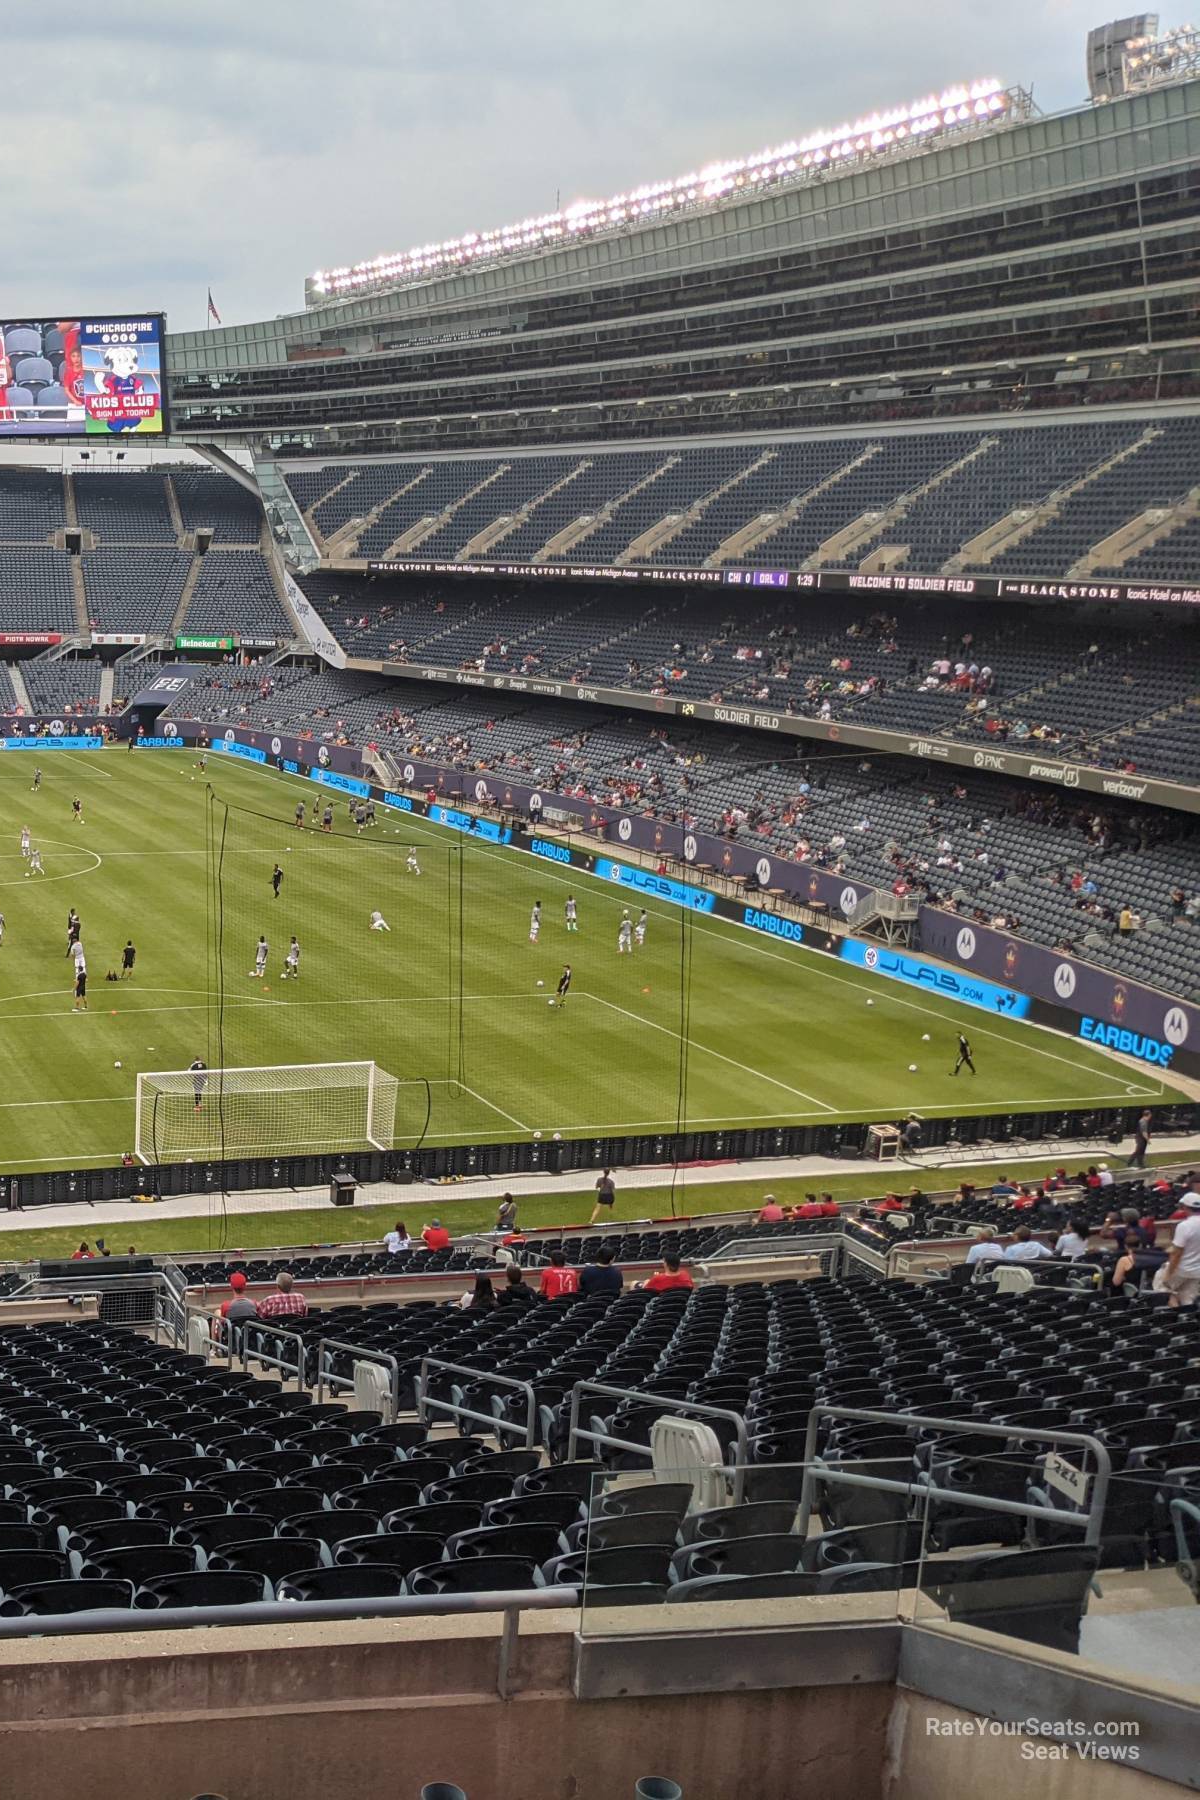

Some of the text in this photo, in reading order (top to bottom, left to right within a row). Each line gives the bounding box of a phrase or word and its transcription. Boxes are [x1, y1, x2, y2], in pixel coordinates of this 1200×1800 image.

[91, 395, 154, 408] KIDS CLUB
[96, 410, 113, 418] SIGN
[114, 409, 123, 417] UP
[378, 563, 432, 573] BLACKSTONE
[507, 566, 567, 576] BLACKSTONE
[570, 567, 584, 576] Iconic
[583, 567, 596, 576] Hotel
[601, 568, 622, 578] Michigan
[621, 569, 638, 578] Avenue
[652, 571, 721, 582] BLACKSTONE
[727, 572, 751, 584] CHI 0
[759, 573, 784, 585] ORL 0
[797, 574, 813, 586] 1:29
[849, 575, 975, 593] WELCOME TO SOLDIER FIELD
[1020, 584, 1120, 599] BLACKSTONE
[1126, 588, 1149, 600] Iconic
[1150, 588, 1170, 601] Hotel
[1170, 592, 1181, 601] on
[180, 639, 217, 648] Heineken
[533, 684, 555, 693] UNITED
[584, 690, 598, 700] PNC
[714, 709, 779, 729] SOLDIER FIELD
[137, 736, 184, 747] EARBUDS
[984, 755, 1005, 770] PNC
[1103, 780, 1142, 798] verizon
[384, 791, 412, 811] EARBUDS
[531, 839, 570, 863] EARBUDS
[743, 907, 803, 941] EARBUDS
[1078, 1015, 1174, 1066] EARBUDS
